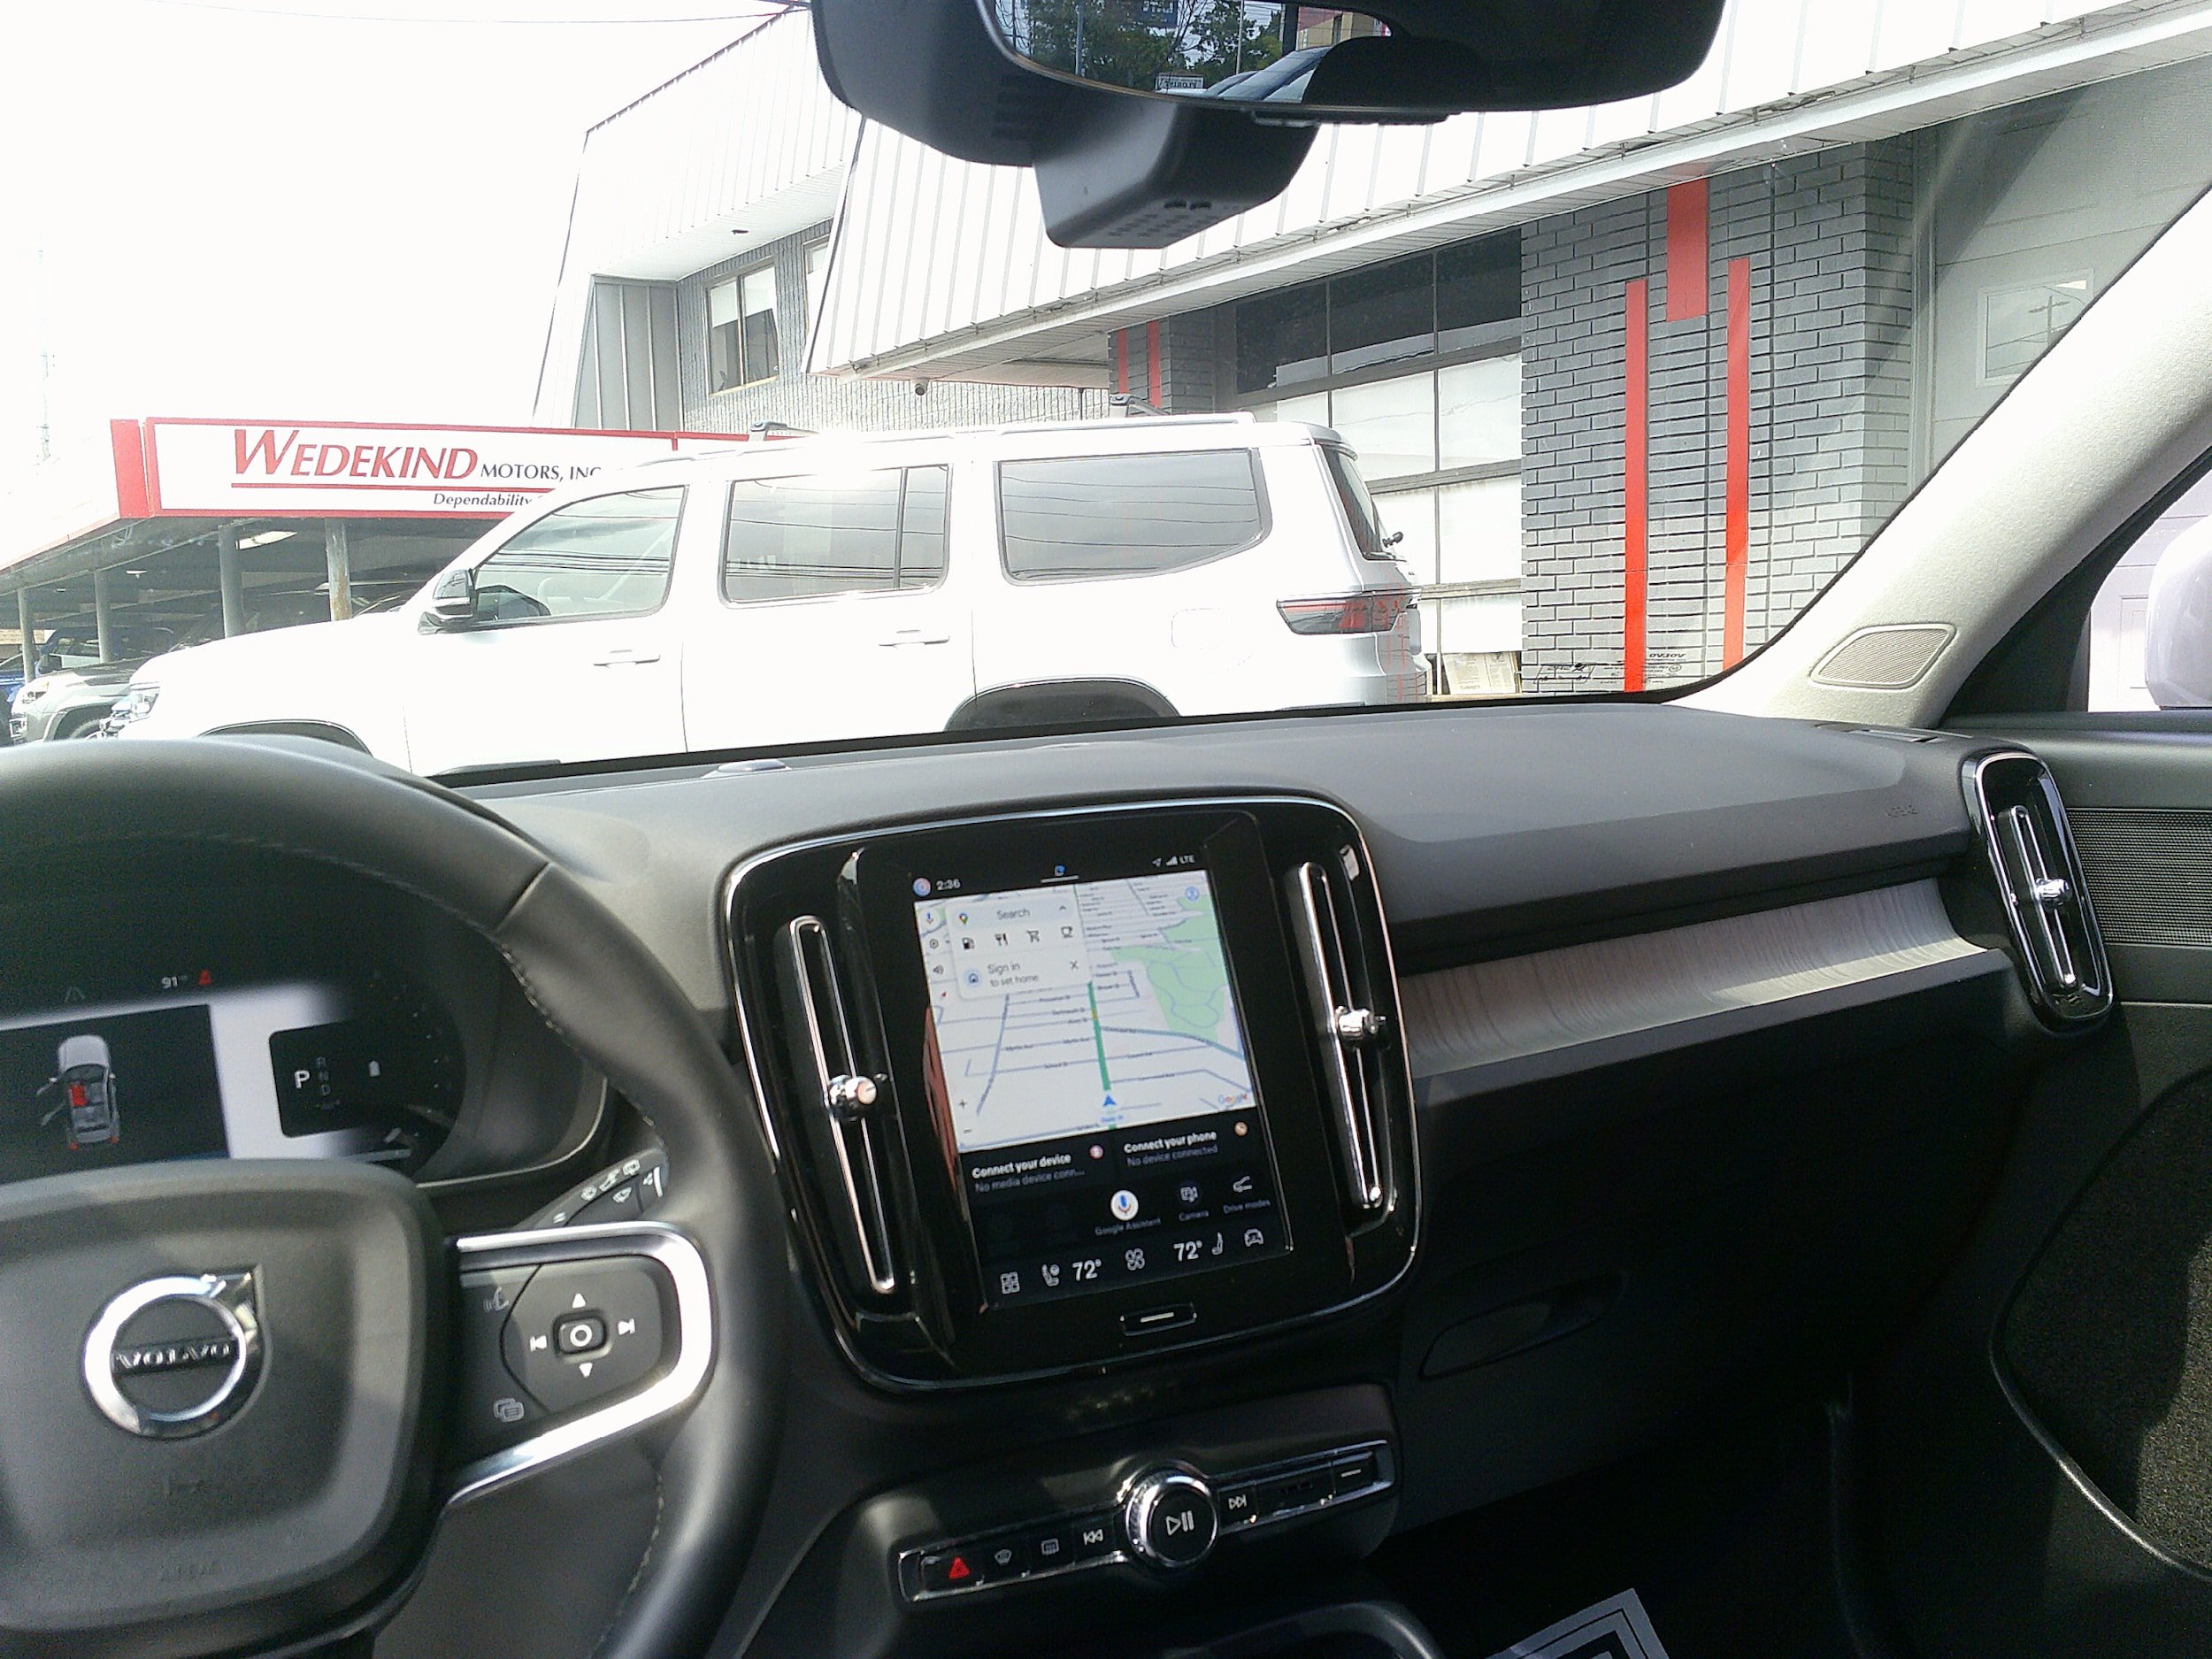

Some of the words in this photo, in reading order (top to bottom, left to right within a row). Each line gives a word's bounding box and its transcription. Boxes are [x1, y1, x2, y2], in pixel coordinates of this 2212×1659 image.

[234, 429, 479, 480] WEDEKIND
[480, 463, 564, 482] MOTORS,
[1179, 855, 1195, 864] LTE
[936, 879, 961, 891] 2:36
[997, 907, 1030, 920] Search
[987, 962, 1010, 975] Sign
[1010, 961, 1021, 972] in
[990, 979, 1000, 987] to
[1001, 976, 1013, 986] set
[1014, 974, 1040, 984] home
[294, 1070, 311, 1089] P
[1124, 1138, 1164, 1154] Connect
[1164, 1136, 1187, 1150] your
[1187, 1132, 1217, 1147] phone
[1126, 1156, 1142, 1168] No
[1142, 1152, 1171, 1165] device
[1171, 1144, 1218, 1161] connected
[972, 1162, 1015, 1179] Connect
[1014, 1159, 1039, 1174] your
[1039, 1154, 1072, 1168] device
[975, 1180, 991, 1193] No
[991, 1177, 1021, 1191] media
[1021, 1172, 1053, 1186] device
[1179, 1210, 1210, 1222] Camera
[1223, 1203, 1243, 1215] Drive
[1244, 1199, 1271, 1210] modes
[1094, 1225, 1125, 1237] Google
[1125, 1217, 1163, 1232] Assistant
[1173, 1240, 1203, 1263] 72°
[1071, 1258, 1102, 1282] 72°
[116, 1343, 230, 1370] VOLVO
